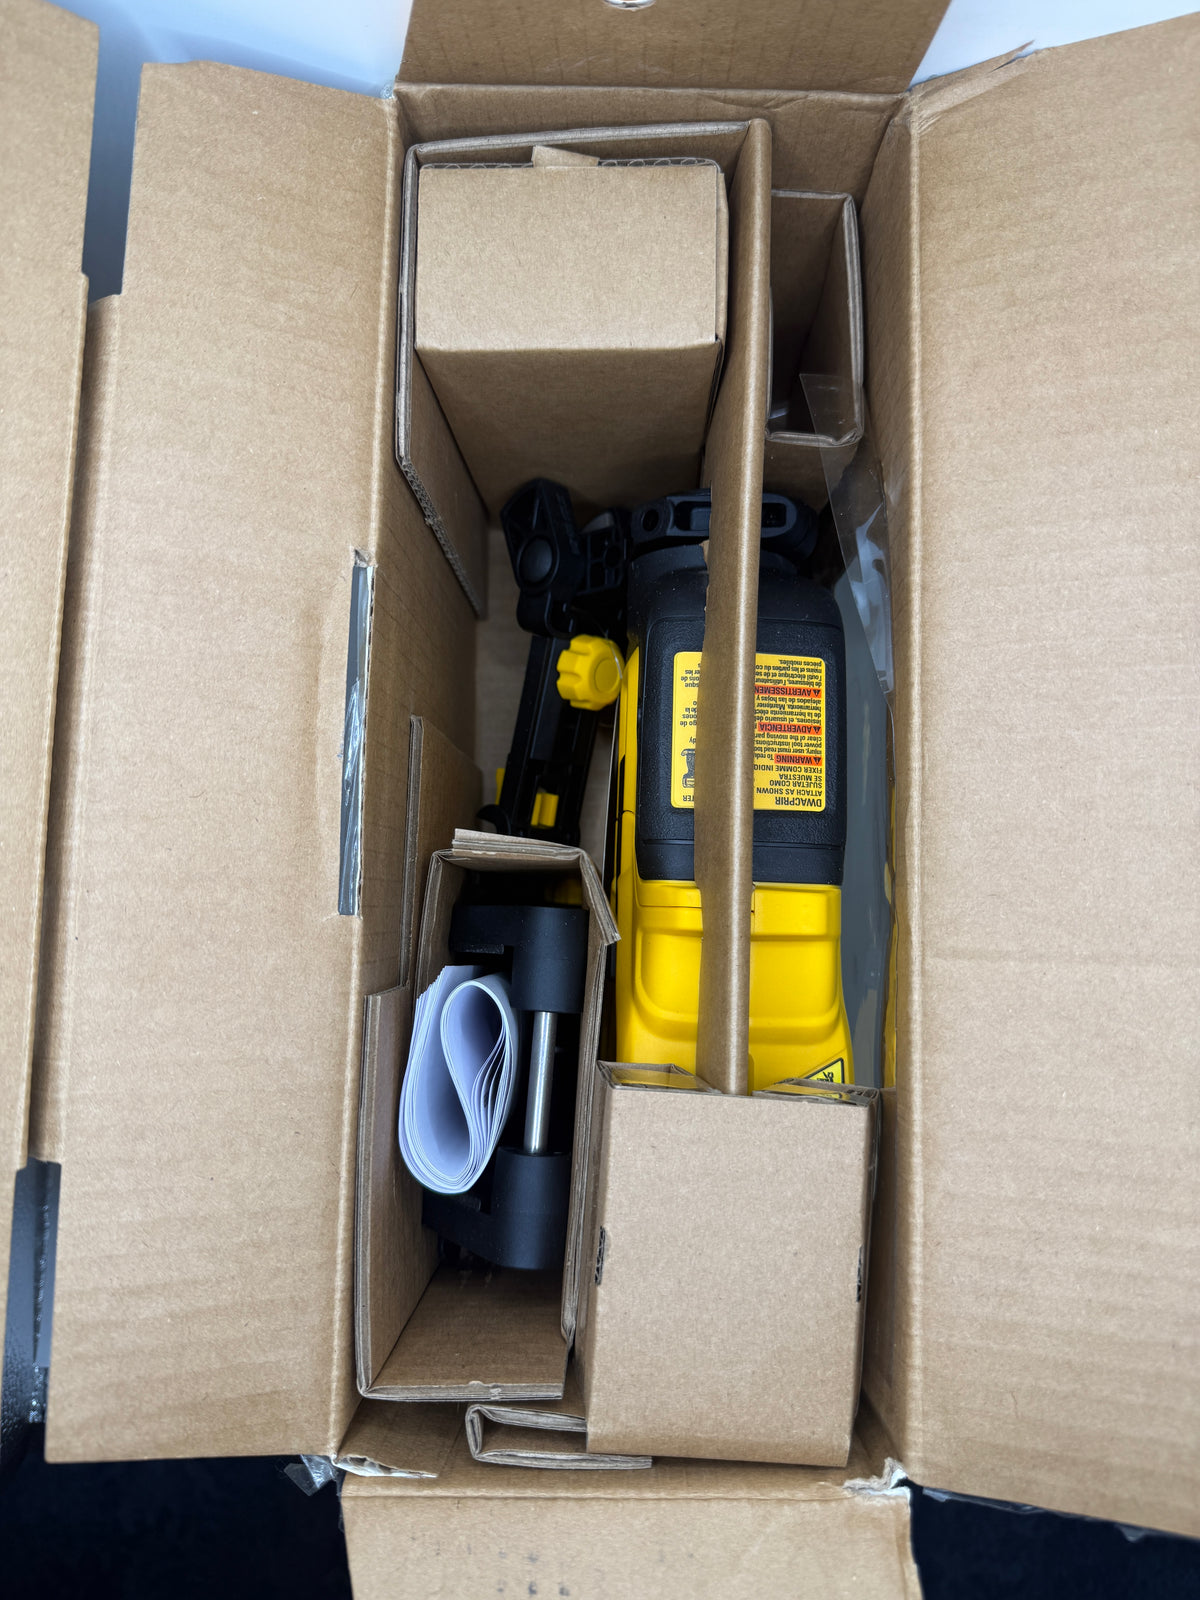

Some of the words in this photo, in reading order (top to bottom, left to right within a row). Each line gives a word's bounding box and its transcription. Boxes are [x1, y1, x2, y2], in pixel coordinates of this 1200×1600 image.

[759, 724, 812, 733] ADVERTENCIA
[776, 755, 812, 764] WARNING
[775, 796, 822, 807] DWACPRIR
